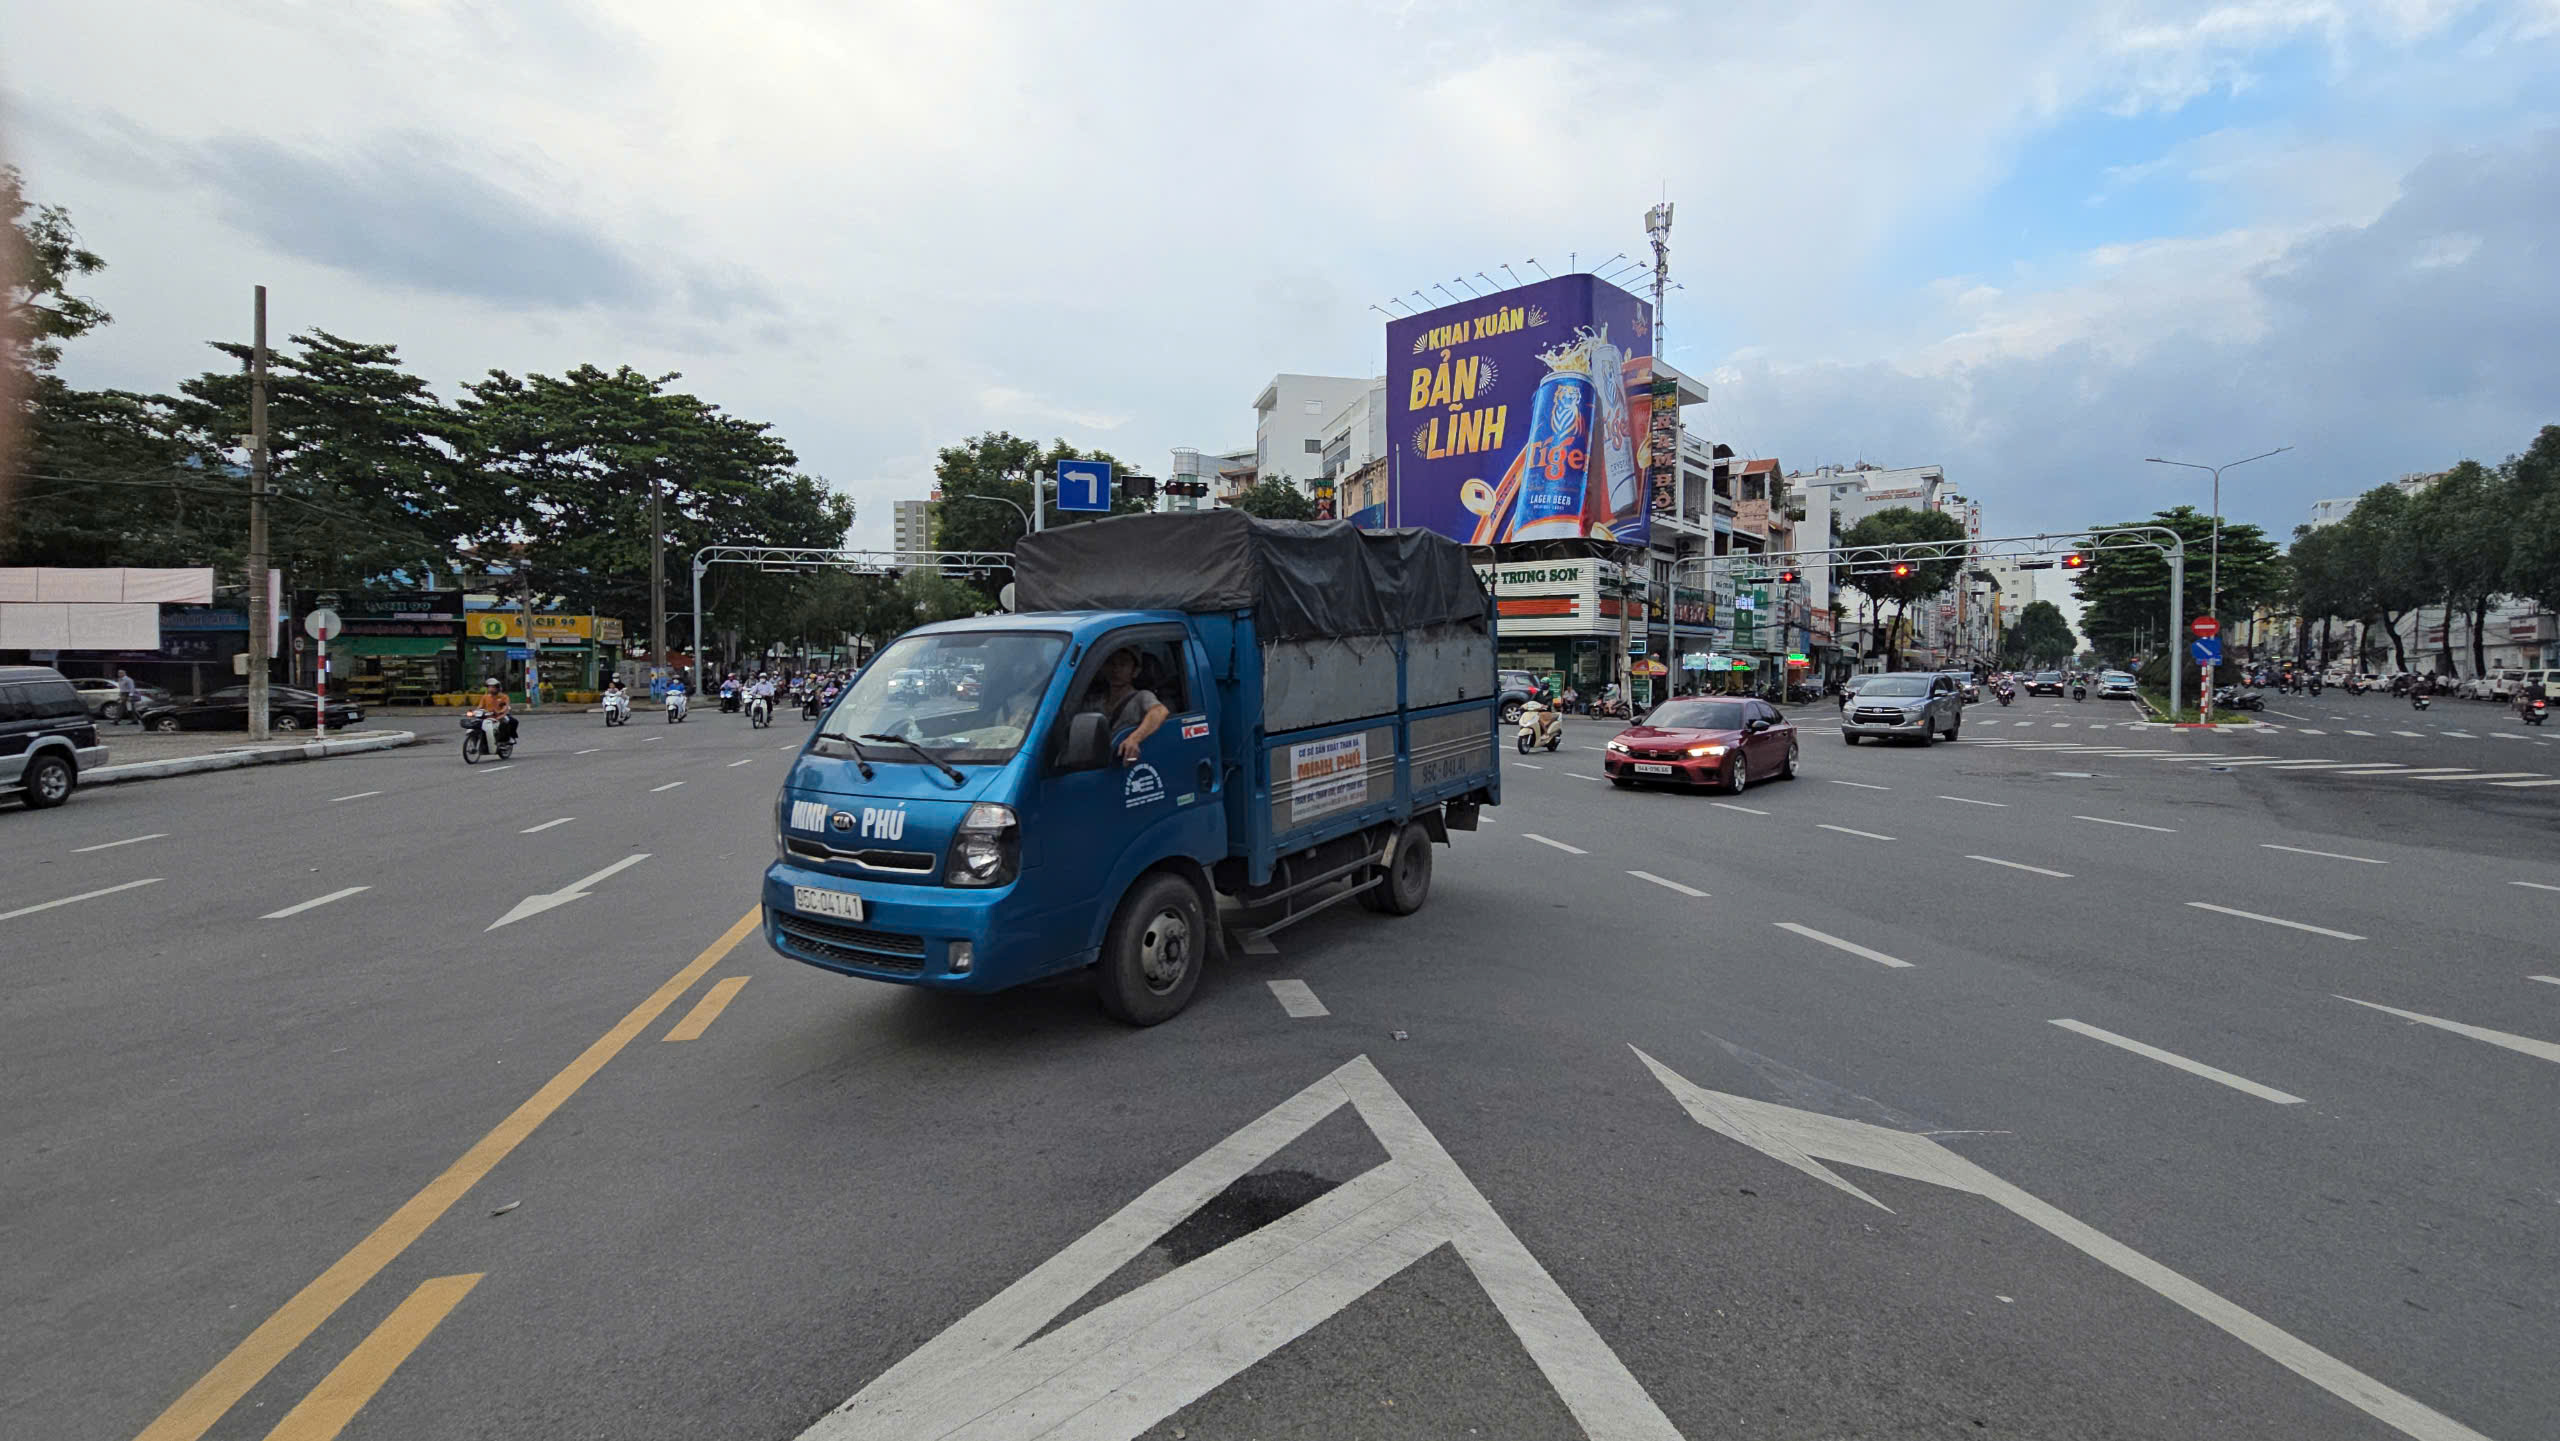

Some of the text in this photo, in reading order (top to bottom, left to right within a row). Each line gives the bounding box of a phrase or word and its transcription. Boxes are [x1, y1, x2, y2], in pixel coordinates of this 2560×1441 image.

[1428, 306, 1525, 351] KHAI XUÂN
[1409, 349, 1479, 411] BẢN
[1426, 402, 1508, 460] LĨNH
[1530, 495, 1571, 505] LAGER BEER
[1501, 570, 1545, 584] TRUNG
[561, 618, 576, 626] 99
[1297, 748, 1361, 779] MINH PHÚ
[791, 800, 829, 833] MINH
[833, 815, 850, 829] KIA
[861, 801, 906, 840] PHÚ
